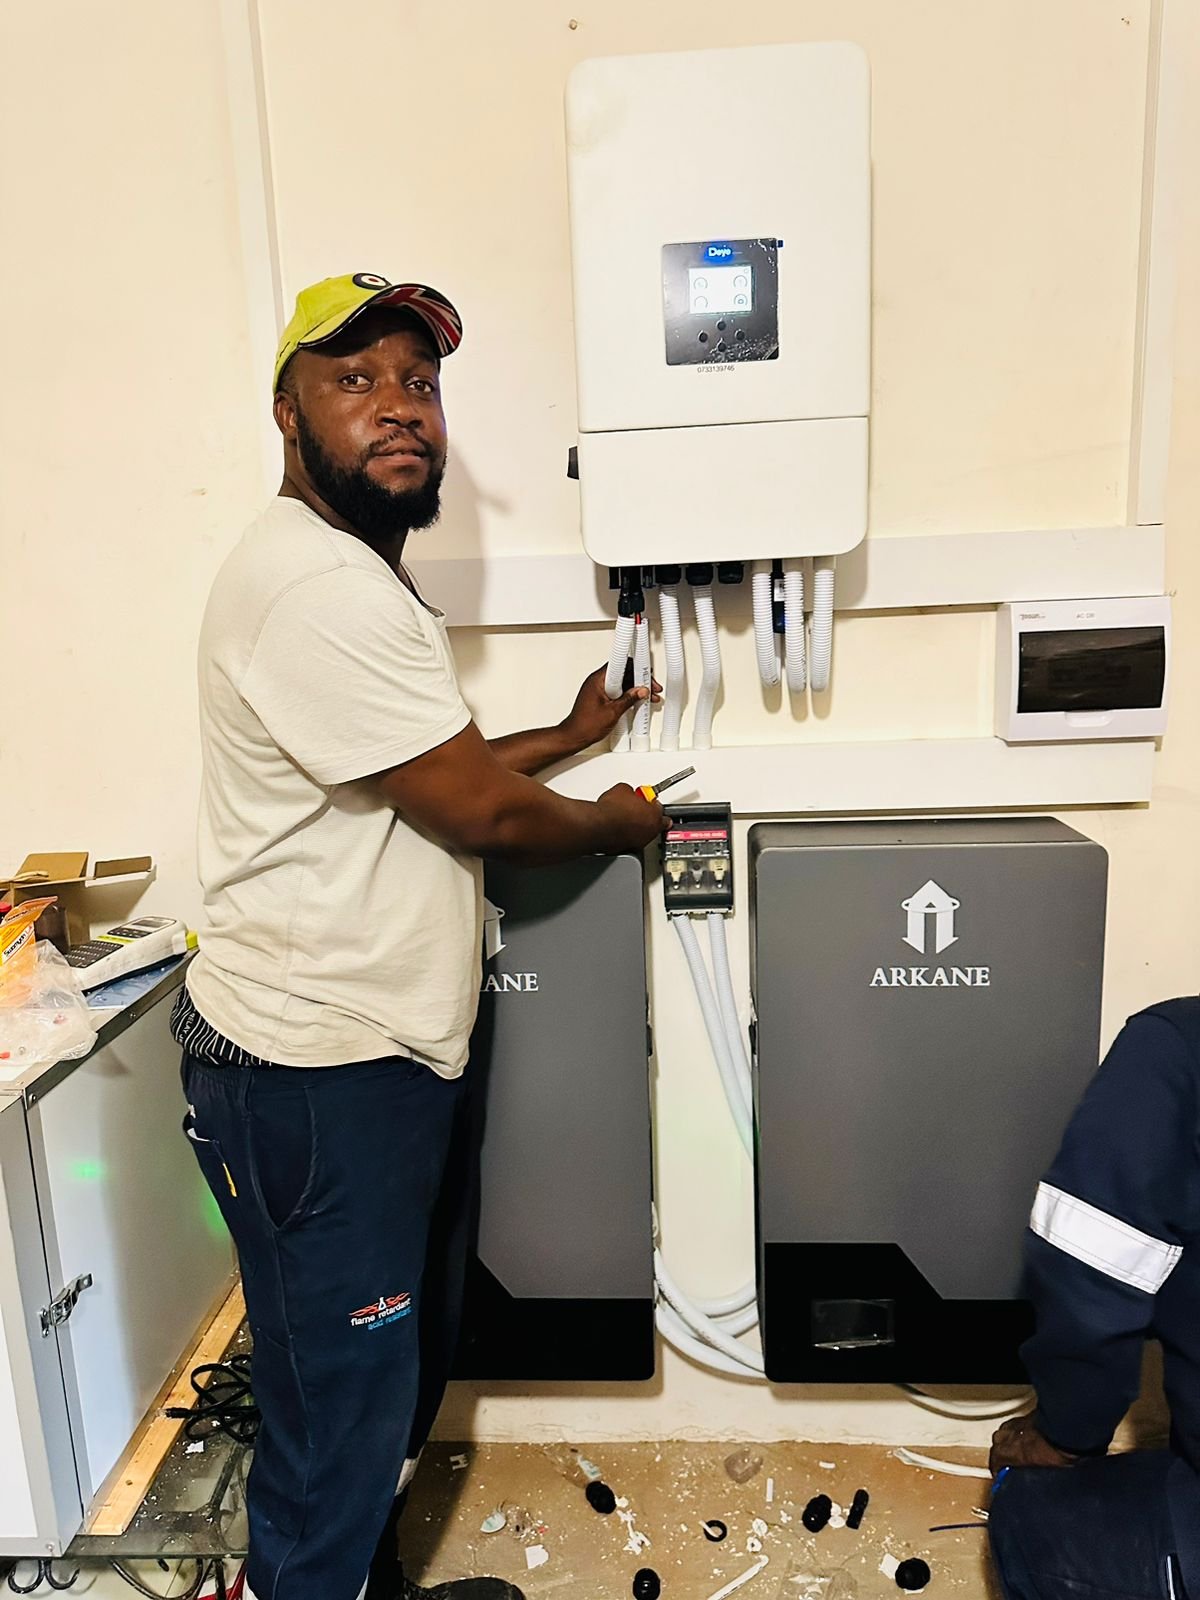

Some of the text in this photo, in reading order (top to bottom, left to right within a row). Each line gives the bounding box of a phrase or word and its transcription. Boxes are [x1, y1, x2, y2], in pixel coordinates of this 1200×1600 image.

[480, 973, 539, 992] ANE
[869, 967, 990, 987] ARKANE
[350, 1298, 411, 1326] flame retardant
